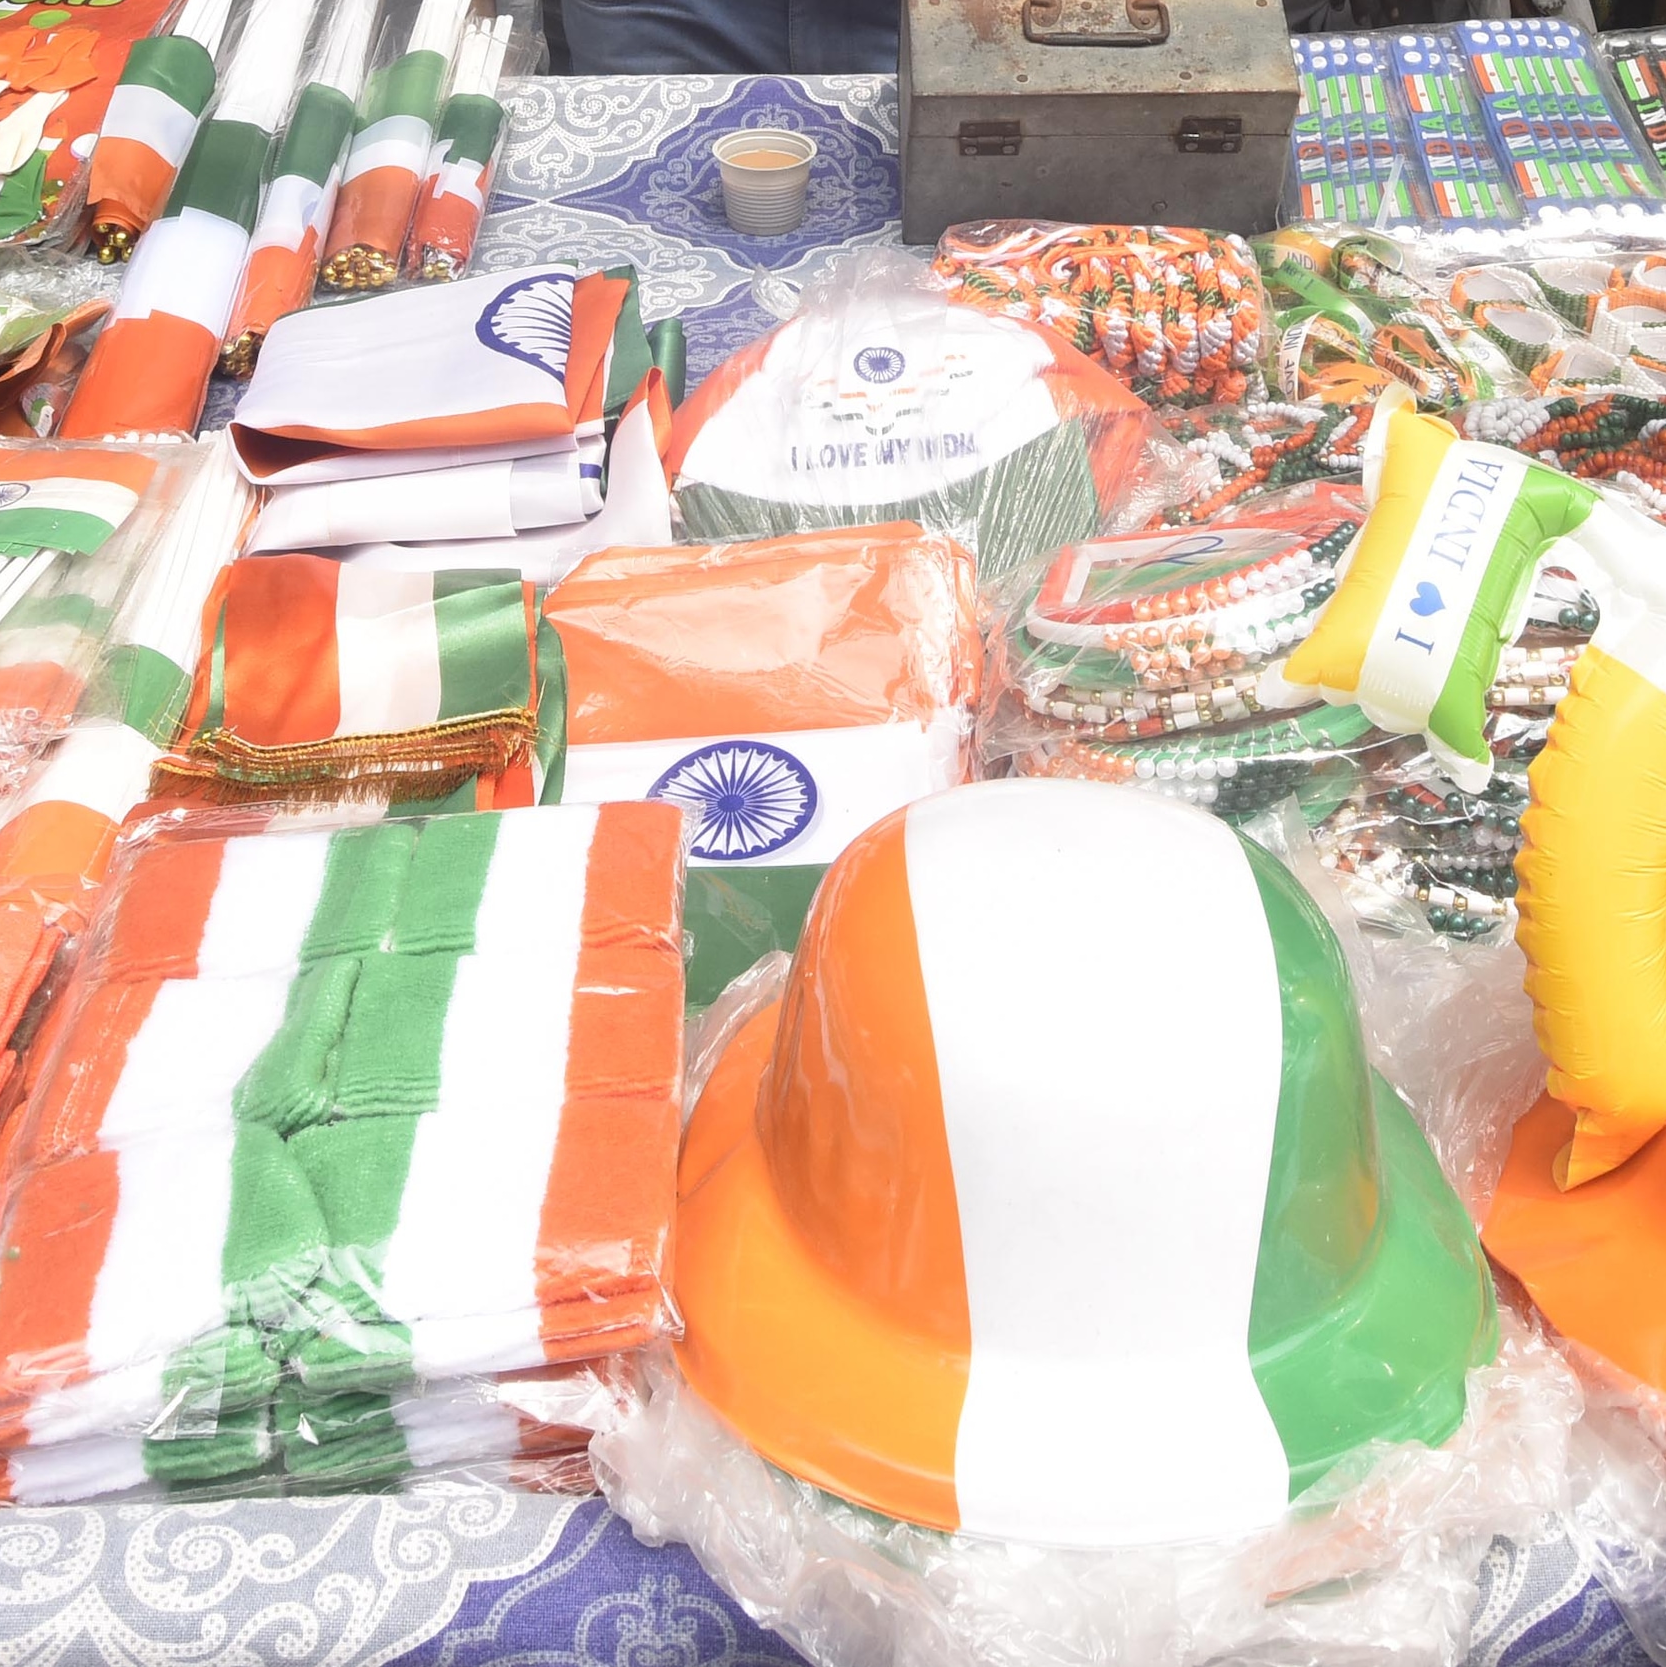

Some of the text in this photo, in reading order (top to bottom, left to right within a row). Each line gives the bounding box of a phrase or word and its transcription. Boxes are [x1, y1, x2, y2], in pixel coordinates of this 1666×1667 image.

[1420, 116, 1459, 178] INDIA
[1492, 95, 1539, 159] INDIA
[1384, 351, 1420, 389] INDIA
[791, 445, 798, 470] I
[803, 441, 868, 470] LOVE
[876, 437, 917, 466] MY
[1394, 456, 1505, 657] I INDIA
